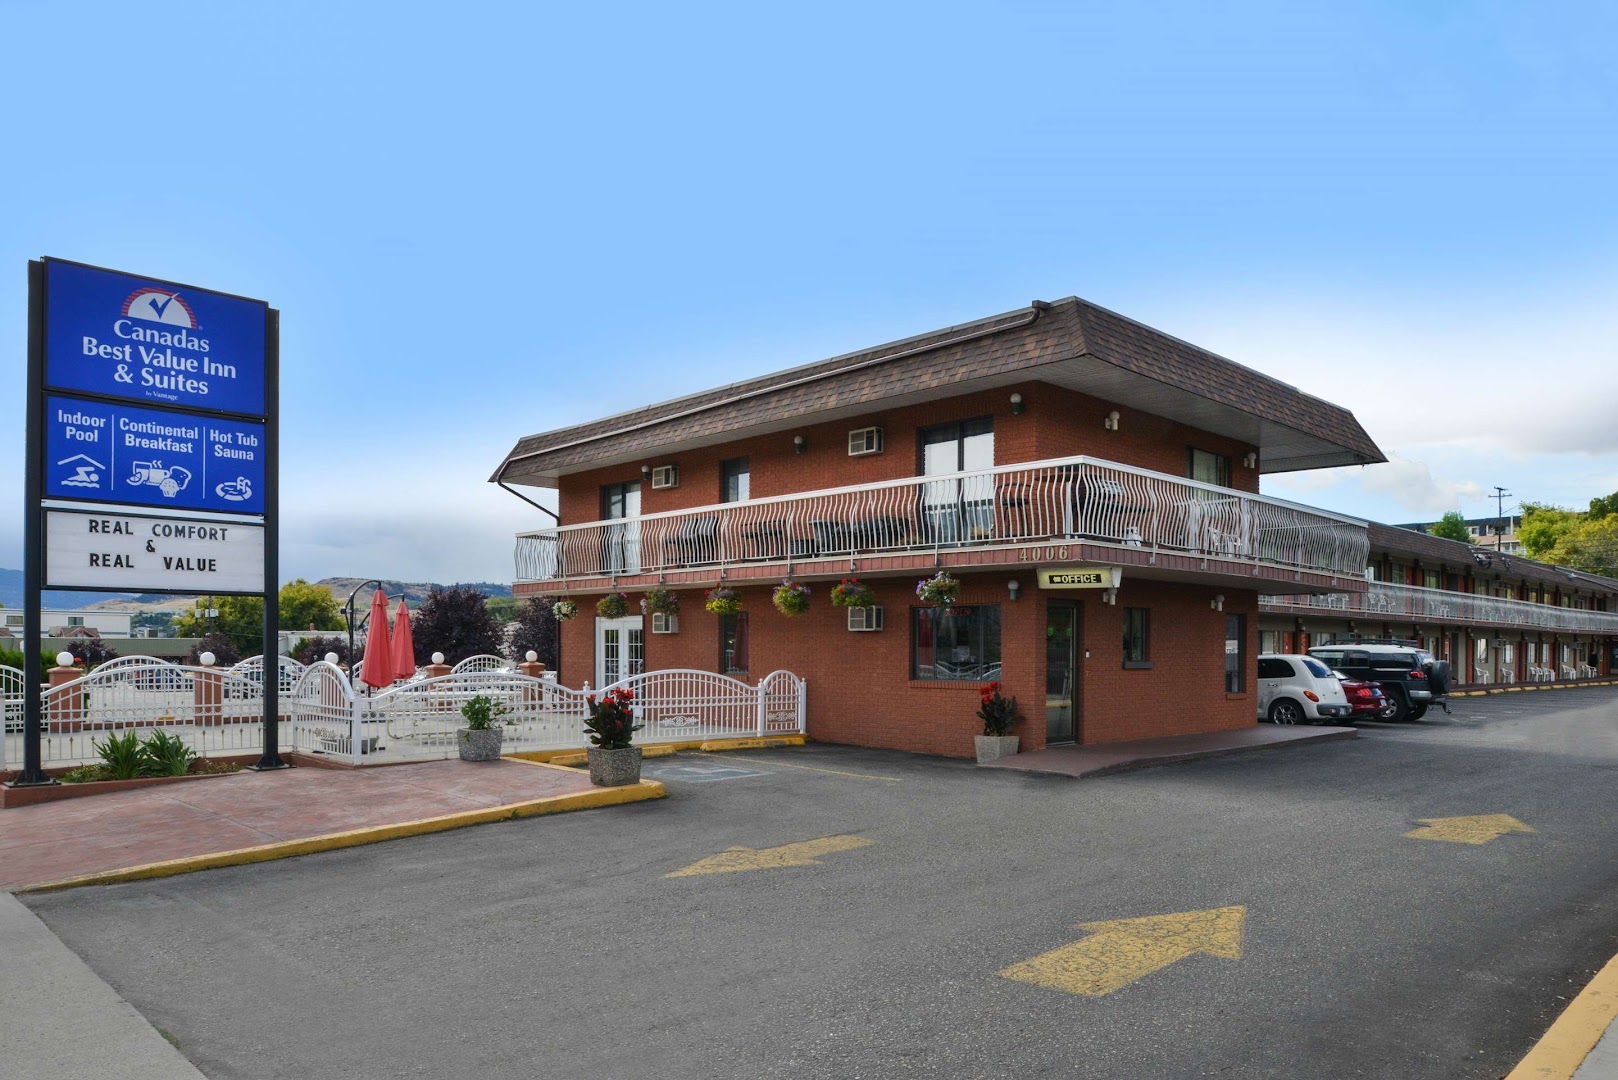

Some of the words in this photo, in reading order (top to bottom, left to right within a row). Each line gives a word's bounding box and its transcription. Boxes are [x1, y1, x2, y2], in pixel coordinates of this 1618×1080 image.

[113, 319, 209, 352] Canadas
[82, 336, 132, 362] Best
[138, 345, 198, 373] Value
[203, 356, 237, 379] Inn
[113, 364, 133, 384] &
[141, 367, 209, 395] Suites
[153, 391, 179, 401] Vantage
[58, 409, 106, 428] Indoor
[119, 417, 199, 439] Continental
[65, 425, 98, 442] Pool
[209, 429, 233, 444] Hot
[235, 432, 258, 447] Tub
[125, 433, 193, 454] Breakfast
[214, 445, 254, 461] Sauna
[88, 519, 134, 536] REAL
[151, 523, 228, 541] COMFORT
[145, 539, 156, 553] &
[1020, 546, 1068, 561] 4006
[89, 553, 135, 568] REAL
[163, 556, 217, 572] VALUE
[1061, 574, 1097, 583] OFFICE
